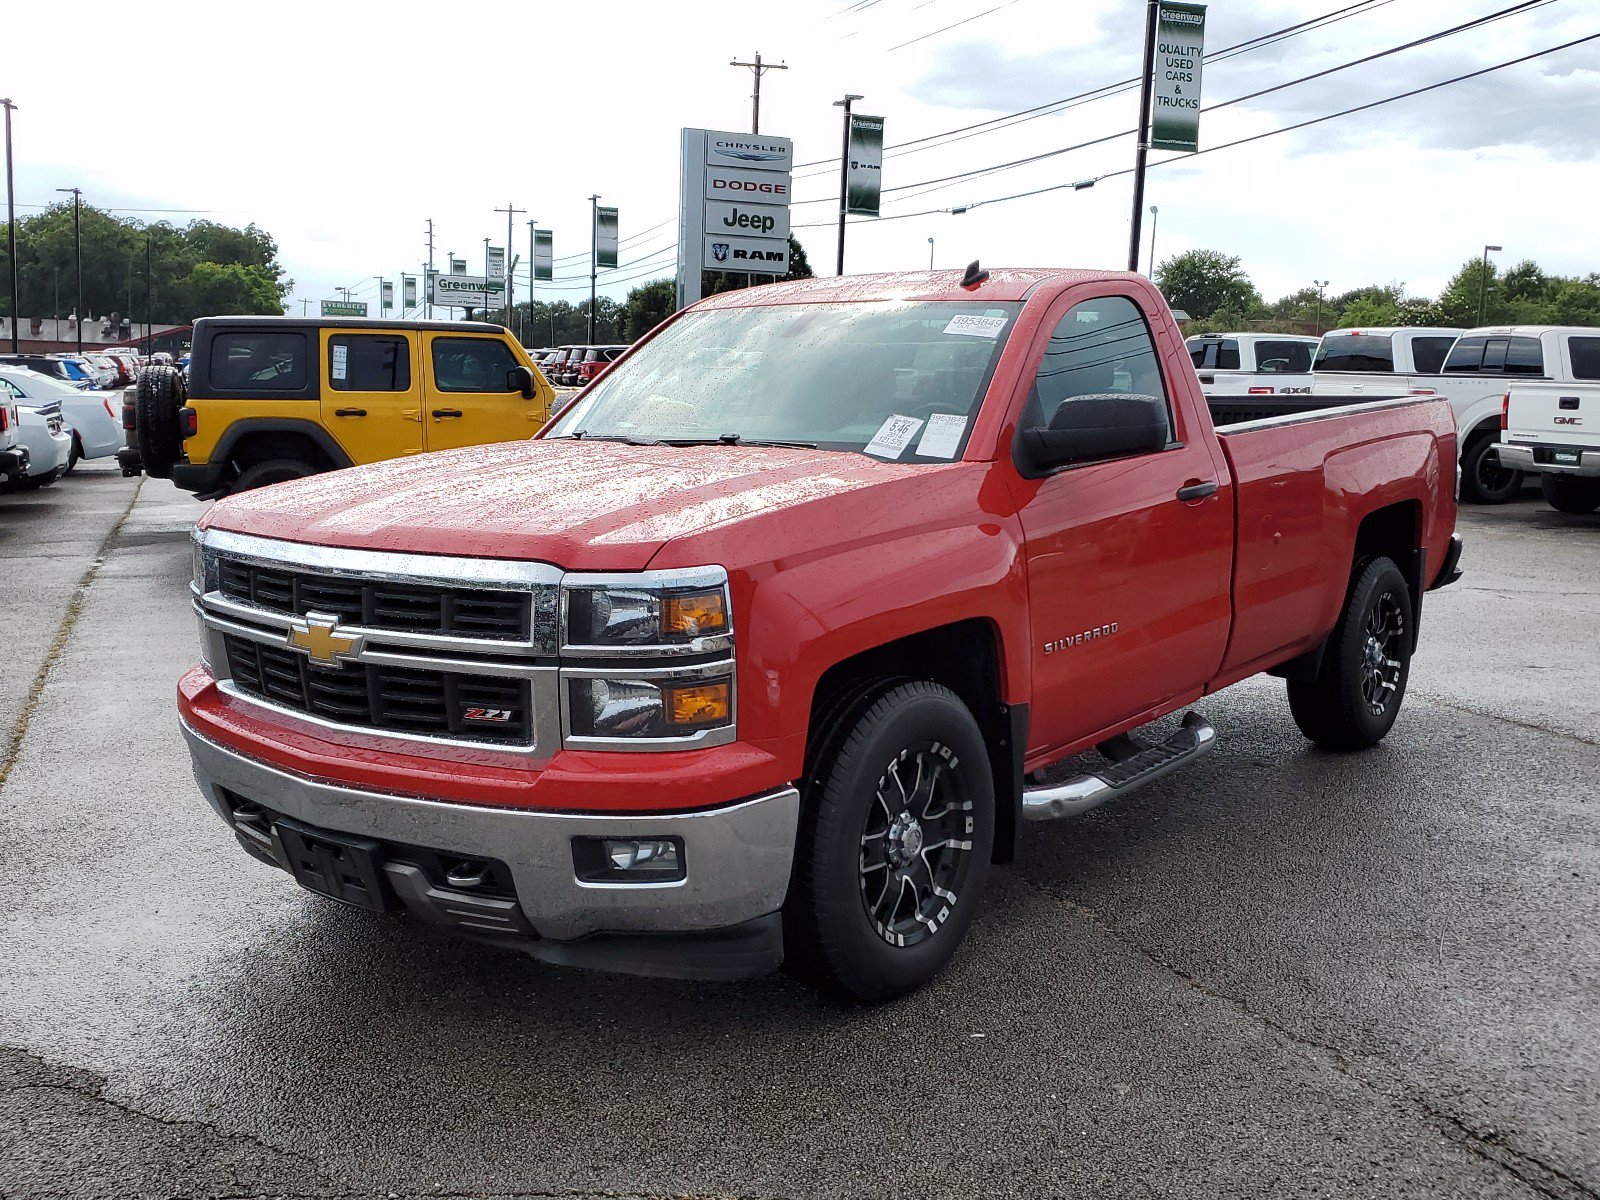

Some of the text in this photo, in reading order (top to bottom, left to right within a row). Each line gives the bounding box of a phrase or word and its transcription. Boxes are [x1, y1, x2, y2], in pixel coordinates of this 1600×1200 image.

[1161, 9, 1204, 23] Greenway
[1158, 43, 1203, 57] QUALITY
[1166, 57, 1193, 70] USED
[1165, 70, 1193, 82] CARS
[1174, 85, 1182, 95] &
[1156, 96, 1198, 109] TRUCKS
[716, 141, 786, 153] CHRYSLER
[713, 179, 787, 194] DODGE
[723, 208, 775, 233] Jeep
[733, 249, 784, 262] RAM
[438, 278, 490, 291] Greenw
[1553, 416, 1583, 426] GMC
[1044, 622, 1119, 655] SILVERADO
[463, 707, 512, 722] Z71
